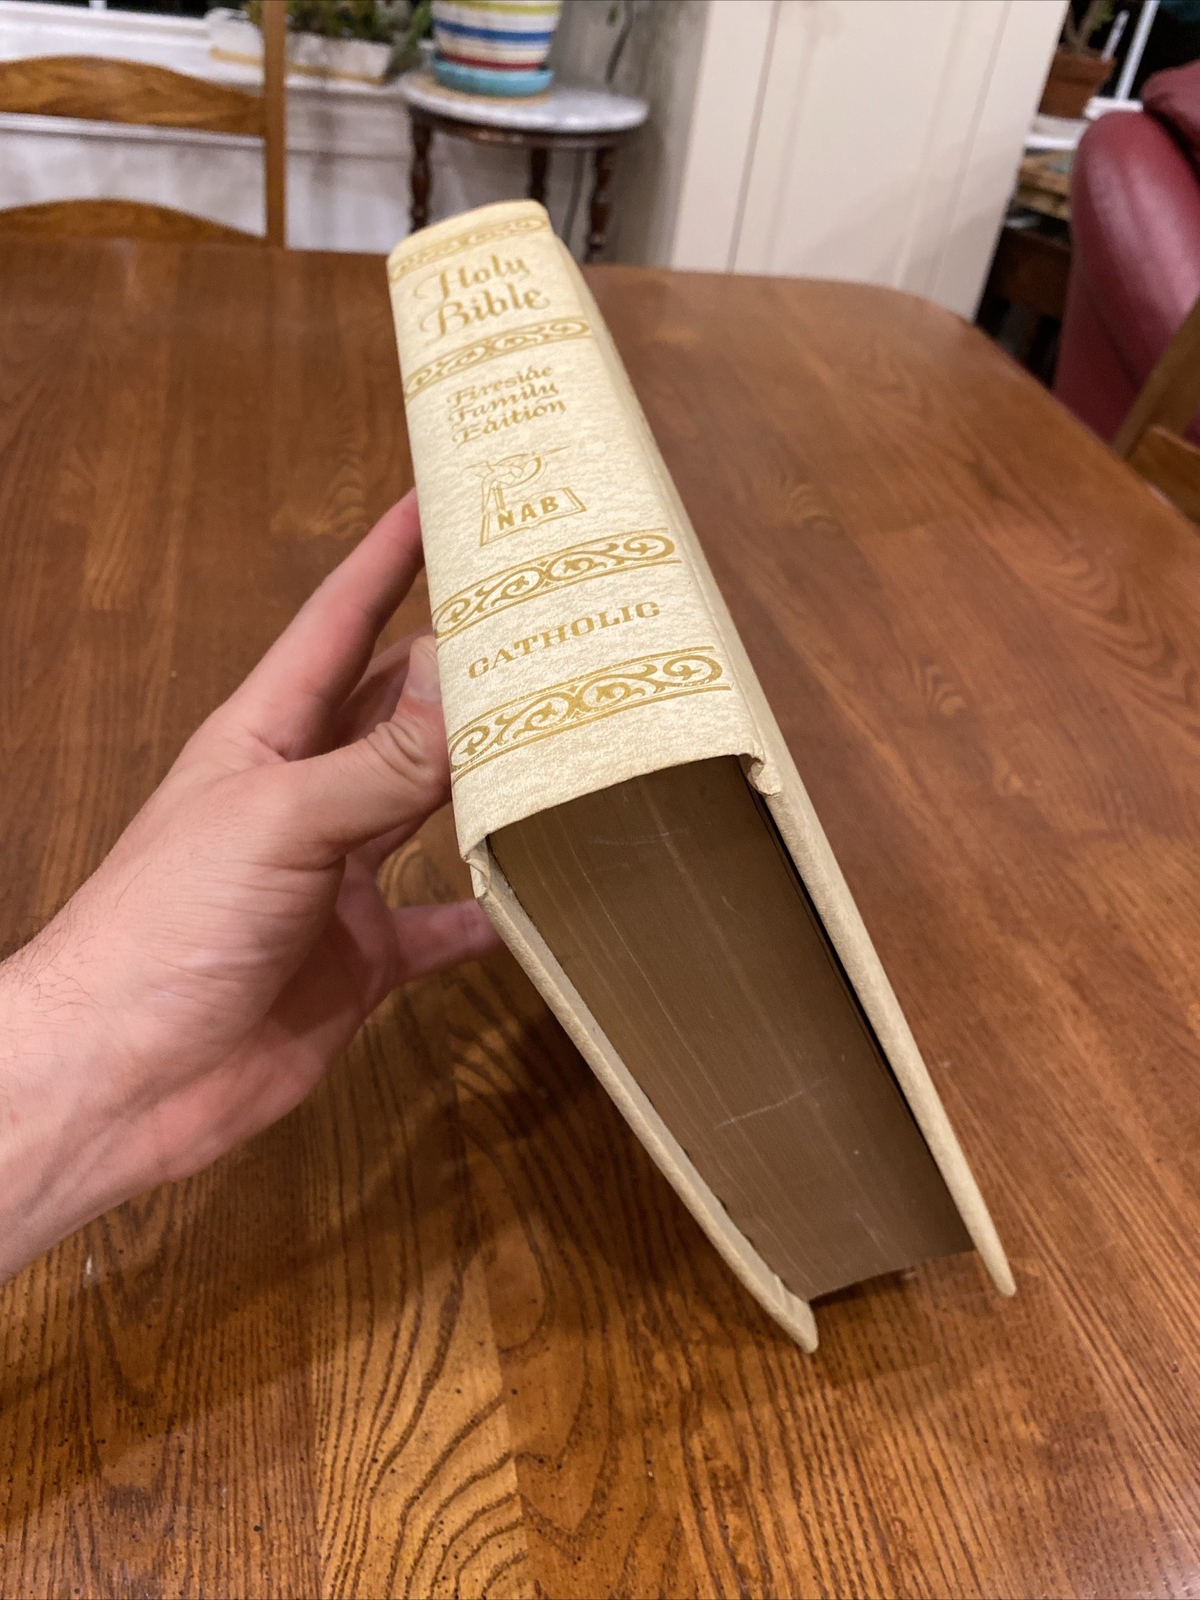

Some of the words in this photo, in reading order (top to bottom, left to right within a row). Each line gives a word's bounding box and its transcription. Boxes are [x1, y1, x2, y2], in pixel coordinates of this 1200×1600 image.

[413, 252, 531, 301] Holy
[419, 283, 550, 346] Bible
[447, 365, 552, 409] Fireside
[448, 382, 559, 428] Family
[452, 399, 566, 449] Edition
[497, 496, 559, 530] NAB
[468, 601, 660, 679] CATHOLIC
